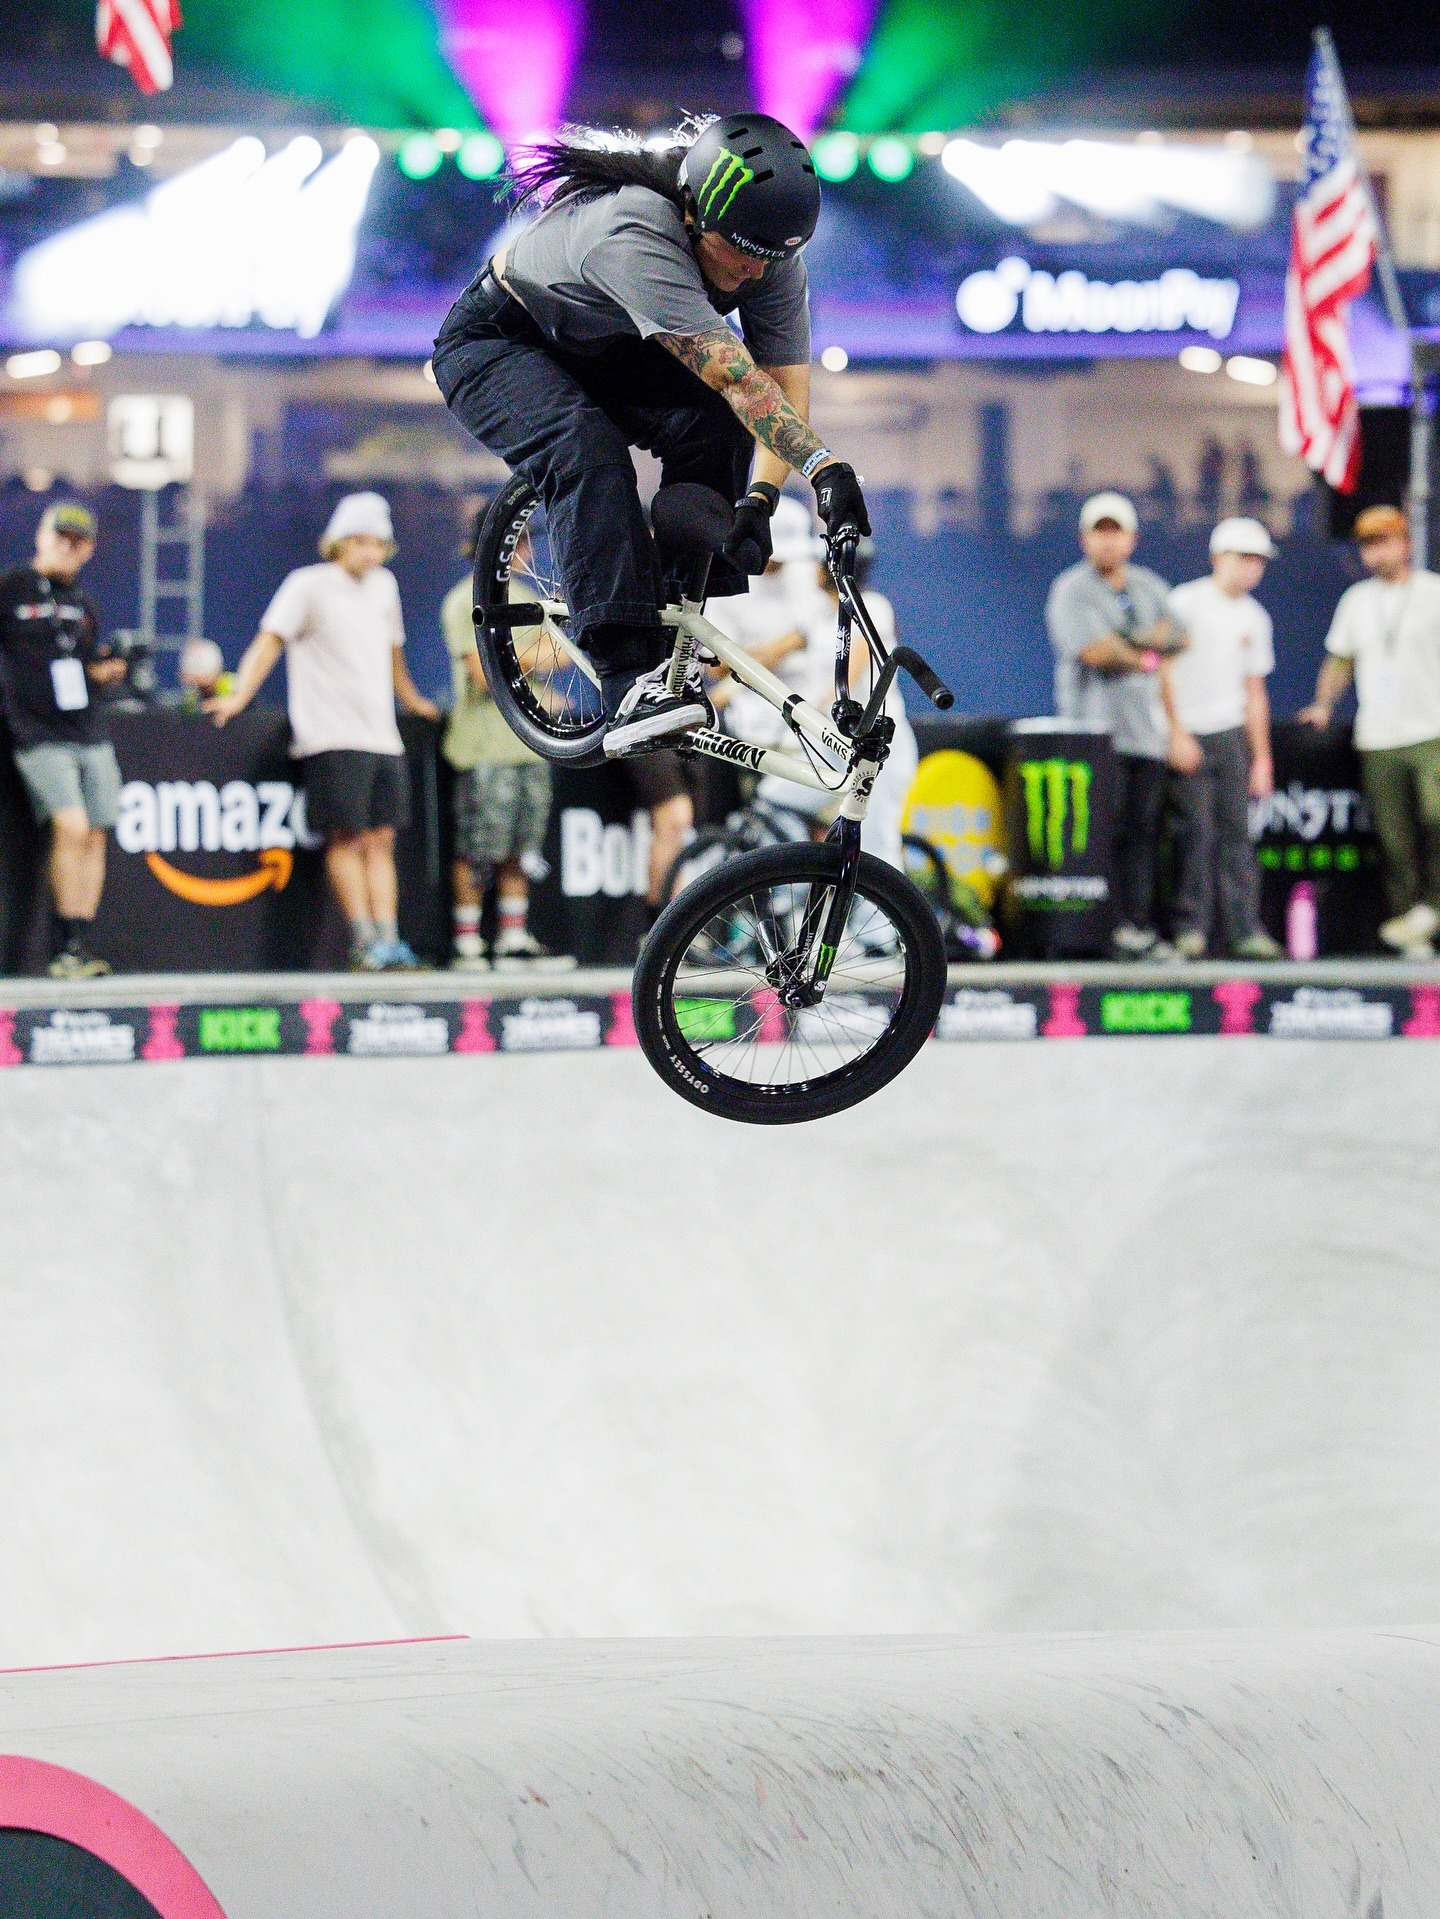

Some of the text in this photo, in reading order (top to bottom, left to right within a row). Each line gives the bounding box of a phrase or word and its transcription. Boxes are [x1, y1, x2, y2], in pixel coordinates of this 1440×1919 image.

[693, 730, 767, 769] unday
[821, 731, 851, 761] VANS
[115, 780, 316, 852] amaz
[561, 806, 651, 897] Bol
[669, 1053, 709, 1094] ODYSSEY
